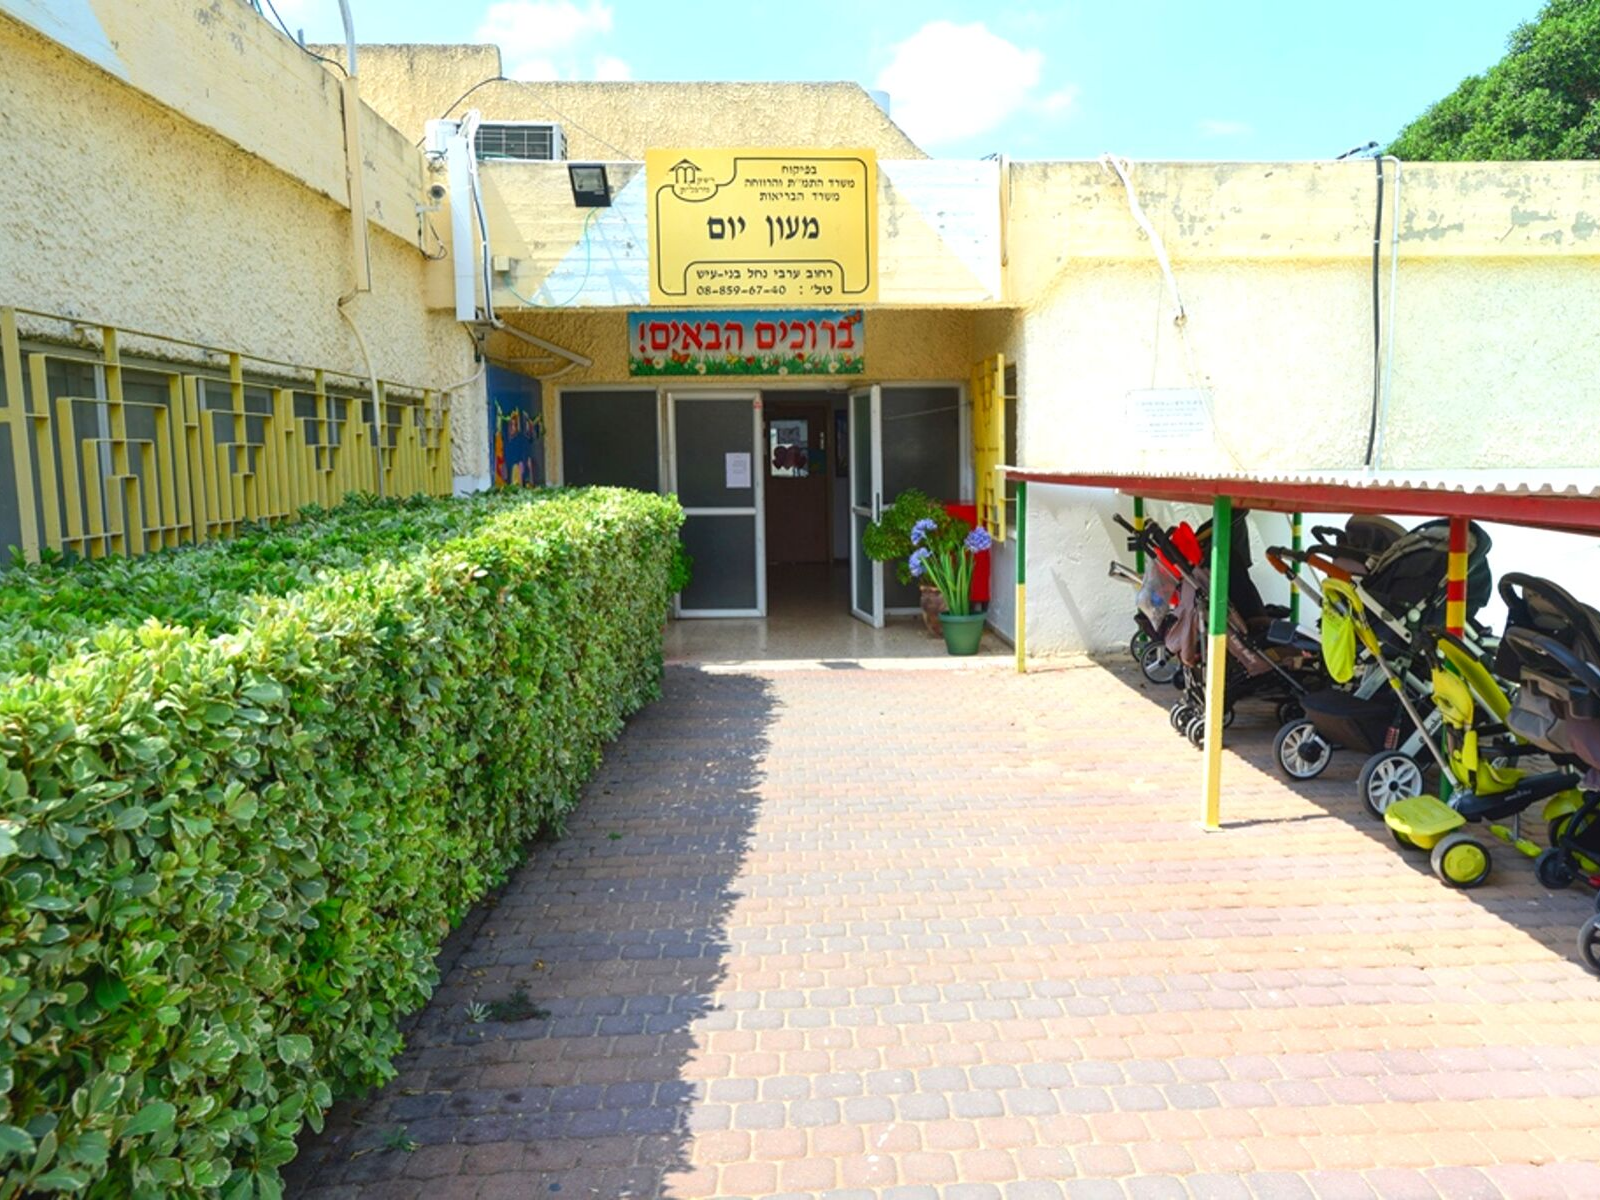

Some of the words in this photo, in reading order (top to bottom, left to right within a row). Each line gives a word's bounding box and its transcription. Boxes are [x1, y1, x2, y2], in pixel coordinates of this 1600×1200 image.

[781, 165, 817, 176] בפיקוח
[828, 179, 856, 189] משרד
[760, 192, 805, 202] הבריאות
[812, 192, 840, 202] משרד
[706, 216, 747, 240] יום
[765, 215, 820, 248] מעון
[747, 268, 768, 279] נחל
[773, 269, 801, 279] ערבי
[805, 269, 833, 279] רחוב
[696, 285, 787, 296] 08-859-67-40
[638, 319, 744, 352] הבאים!
[753, 319, 855, 350] ברוכים
